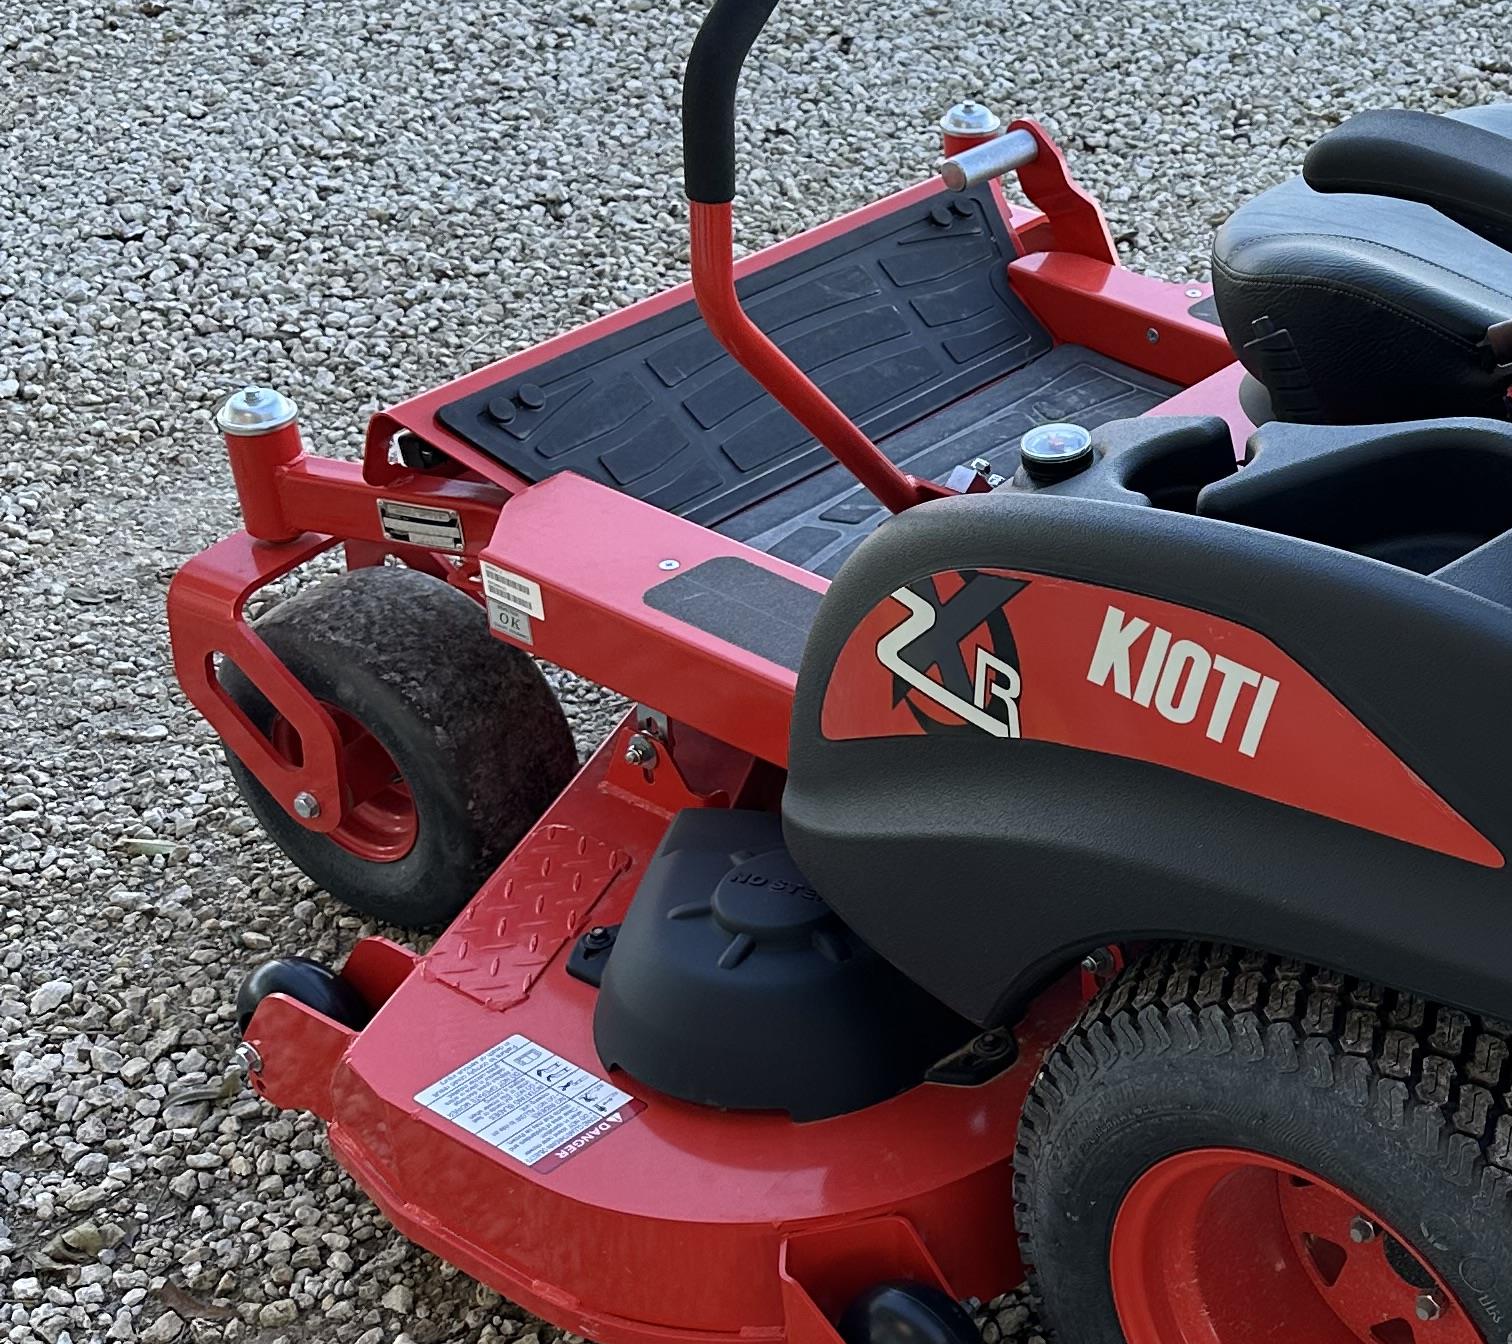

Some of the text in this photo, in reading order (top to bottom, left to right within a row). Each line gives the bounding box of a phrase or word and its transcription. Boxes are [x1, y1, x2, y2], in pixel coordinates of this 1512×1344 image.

[499, 612, 521, 631] OK
[1086, 605, 1280, 758] KIOTI
[730, 872, 769, 887] NO
[555, 1122, 611, 1159] DANGER
